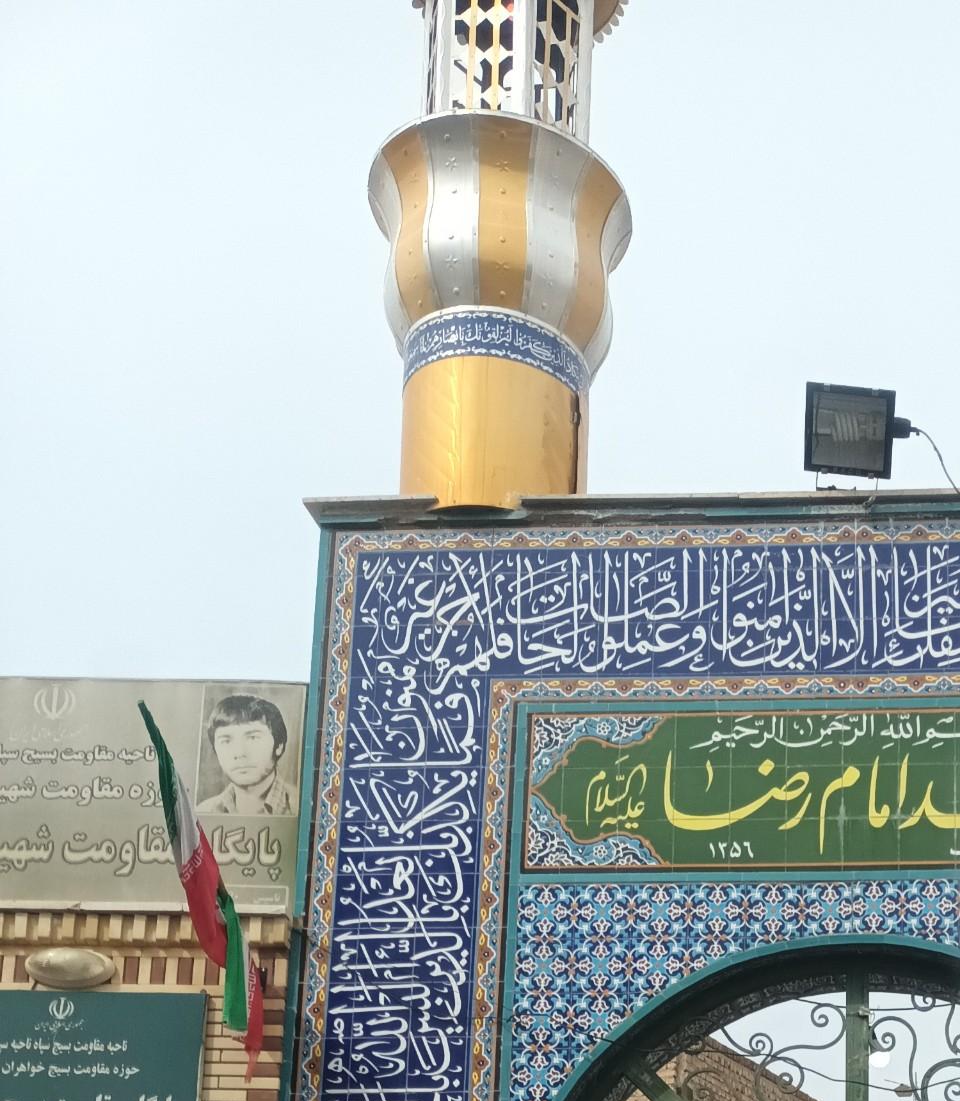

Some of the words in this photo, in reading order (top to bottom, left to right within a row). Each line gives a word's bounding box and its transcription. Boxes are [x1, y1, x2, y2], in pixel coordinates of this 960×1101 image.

[880, 713, 920, 749] الله
[21, 748, 58, 765] بسیج
[60, 744, 115, 765] مقاومت
[0, 776, 36, 803] شهی
[42, 776, 124, 806] مقاومت
[664, 750, 811, 831] رضا
[818, 753, 909, 854] امام
[0, 824, 54, 872] شهی
[212, 826, 281, 881] پایگا
[73, 1038, 105, 1055] مقاومت
[2, 1060, 45, 1077] خواهران
[48, 1064, 71, 1077] بسیج
[73, 1062, 110, 1077] مقاومت
[113, 1063, 140, 1079] حوزه
